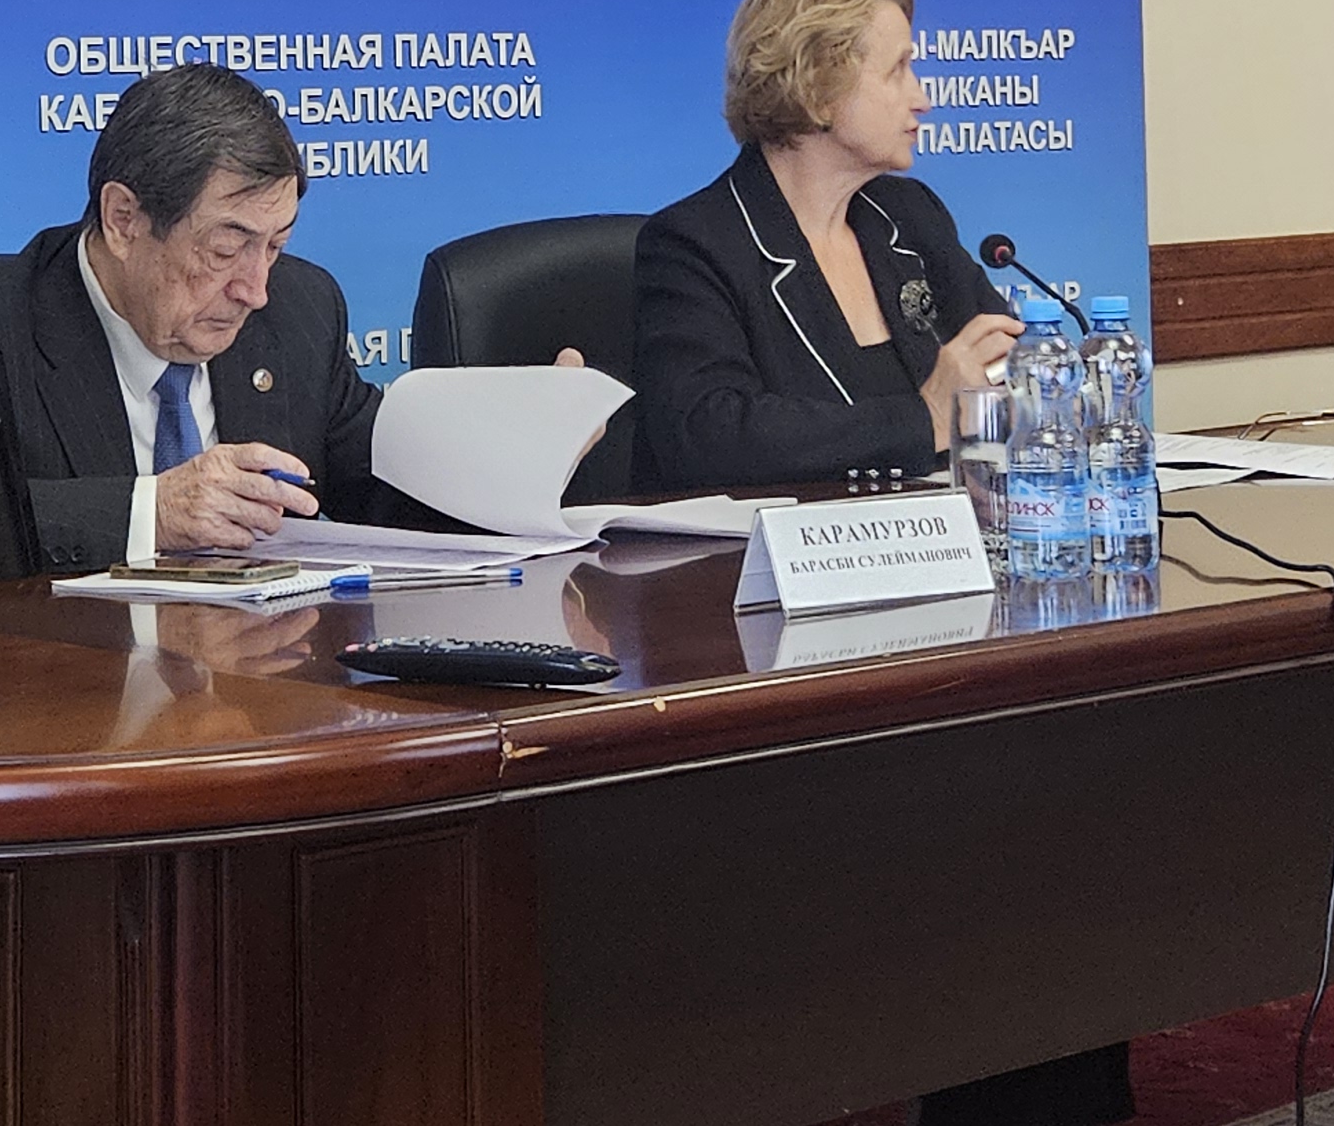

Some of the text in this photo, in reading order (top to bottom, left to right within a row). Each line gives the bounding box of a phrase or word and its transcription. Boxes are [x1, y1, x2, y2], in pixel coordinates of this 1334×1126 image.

[45, 32, 536, 80] ОБЩЕСТВЕННАЯ ПАЛАТА
[917, 120, 1073, 154] ПАЛАТАСЫ
[298, 138, 428, 178] БЛИКИ
[800, 516, 949, 547] КАРАМУРЗОВ
[790, 546, 973, 575] БАРАСБИ СУЛЕЙМАНОВИЧ
